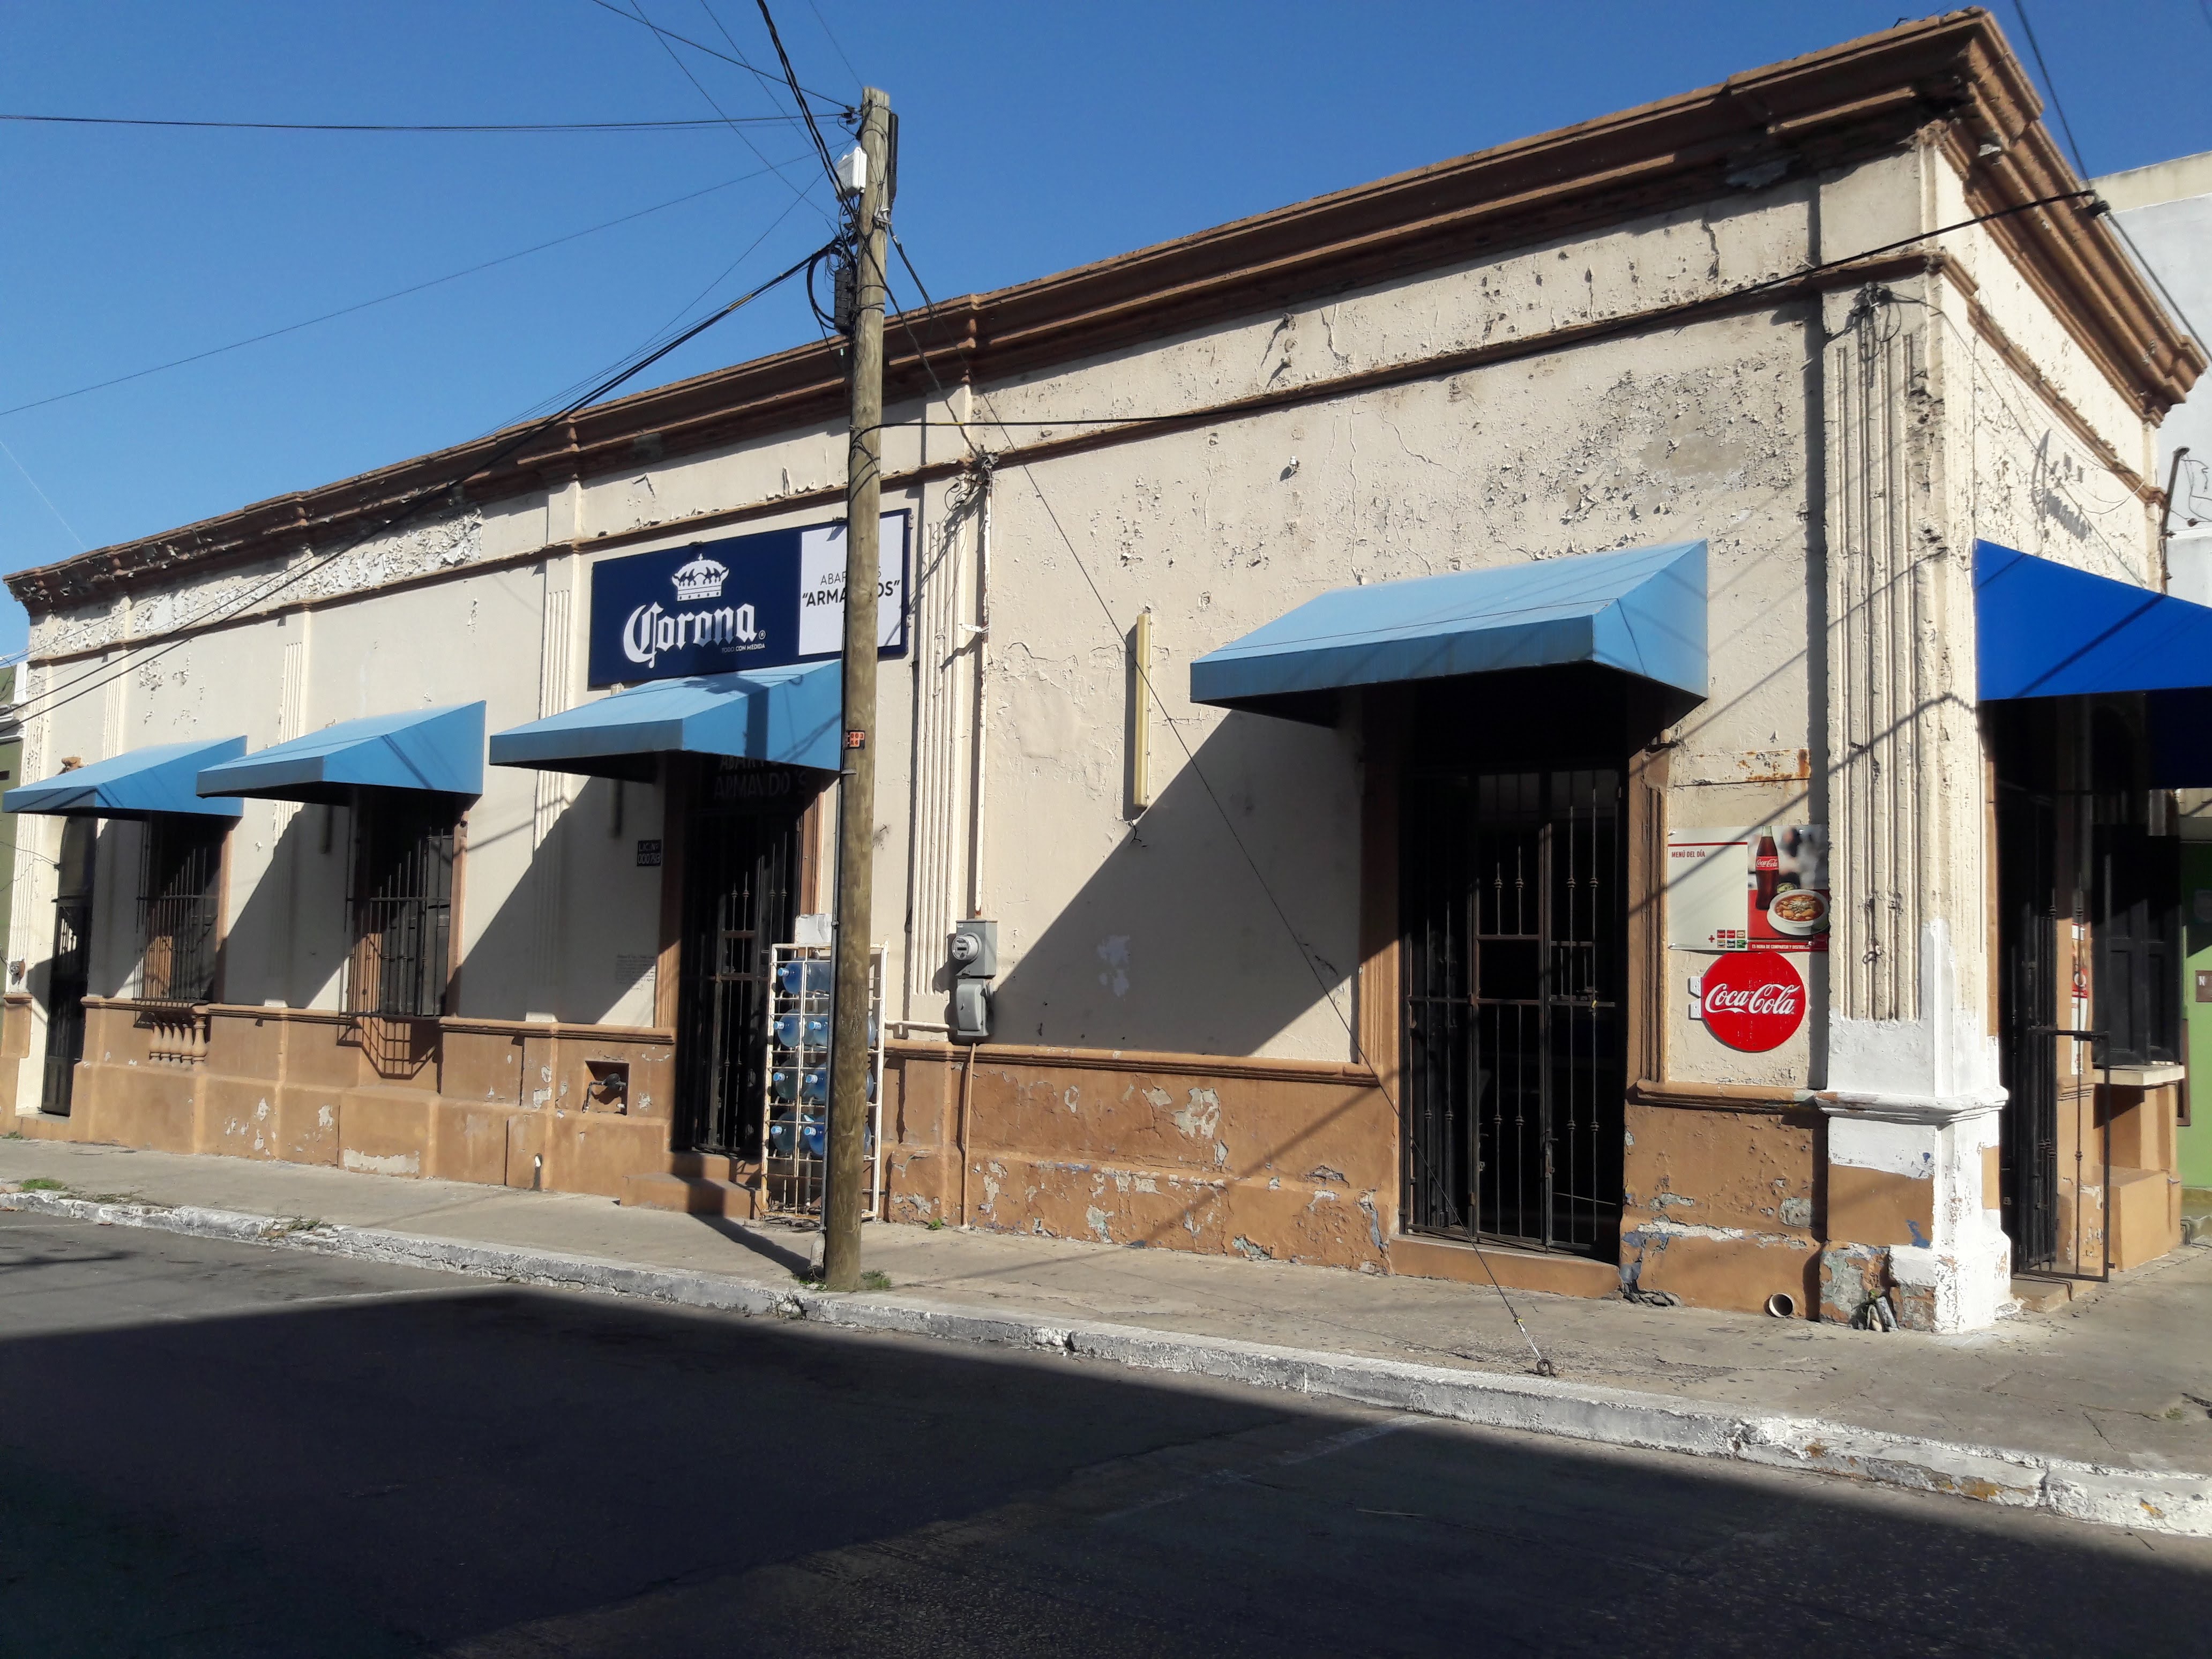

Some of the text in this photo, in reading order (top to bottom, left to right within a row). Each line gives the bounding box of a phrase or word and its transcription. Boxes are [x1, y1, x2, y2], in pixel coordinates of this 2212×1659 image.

[623, 601, 757, 669] Corona
[1671, 849, 1685, 858] MENÚ
[1697, 849, 1706, 857] DÍA
[1705, 983, 1801, 1015] Coca-Cola
